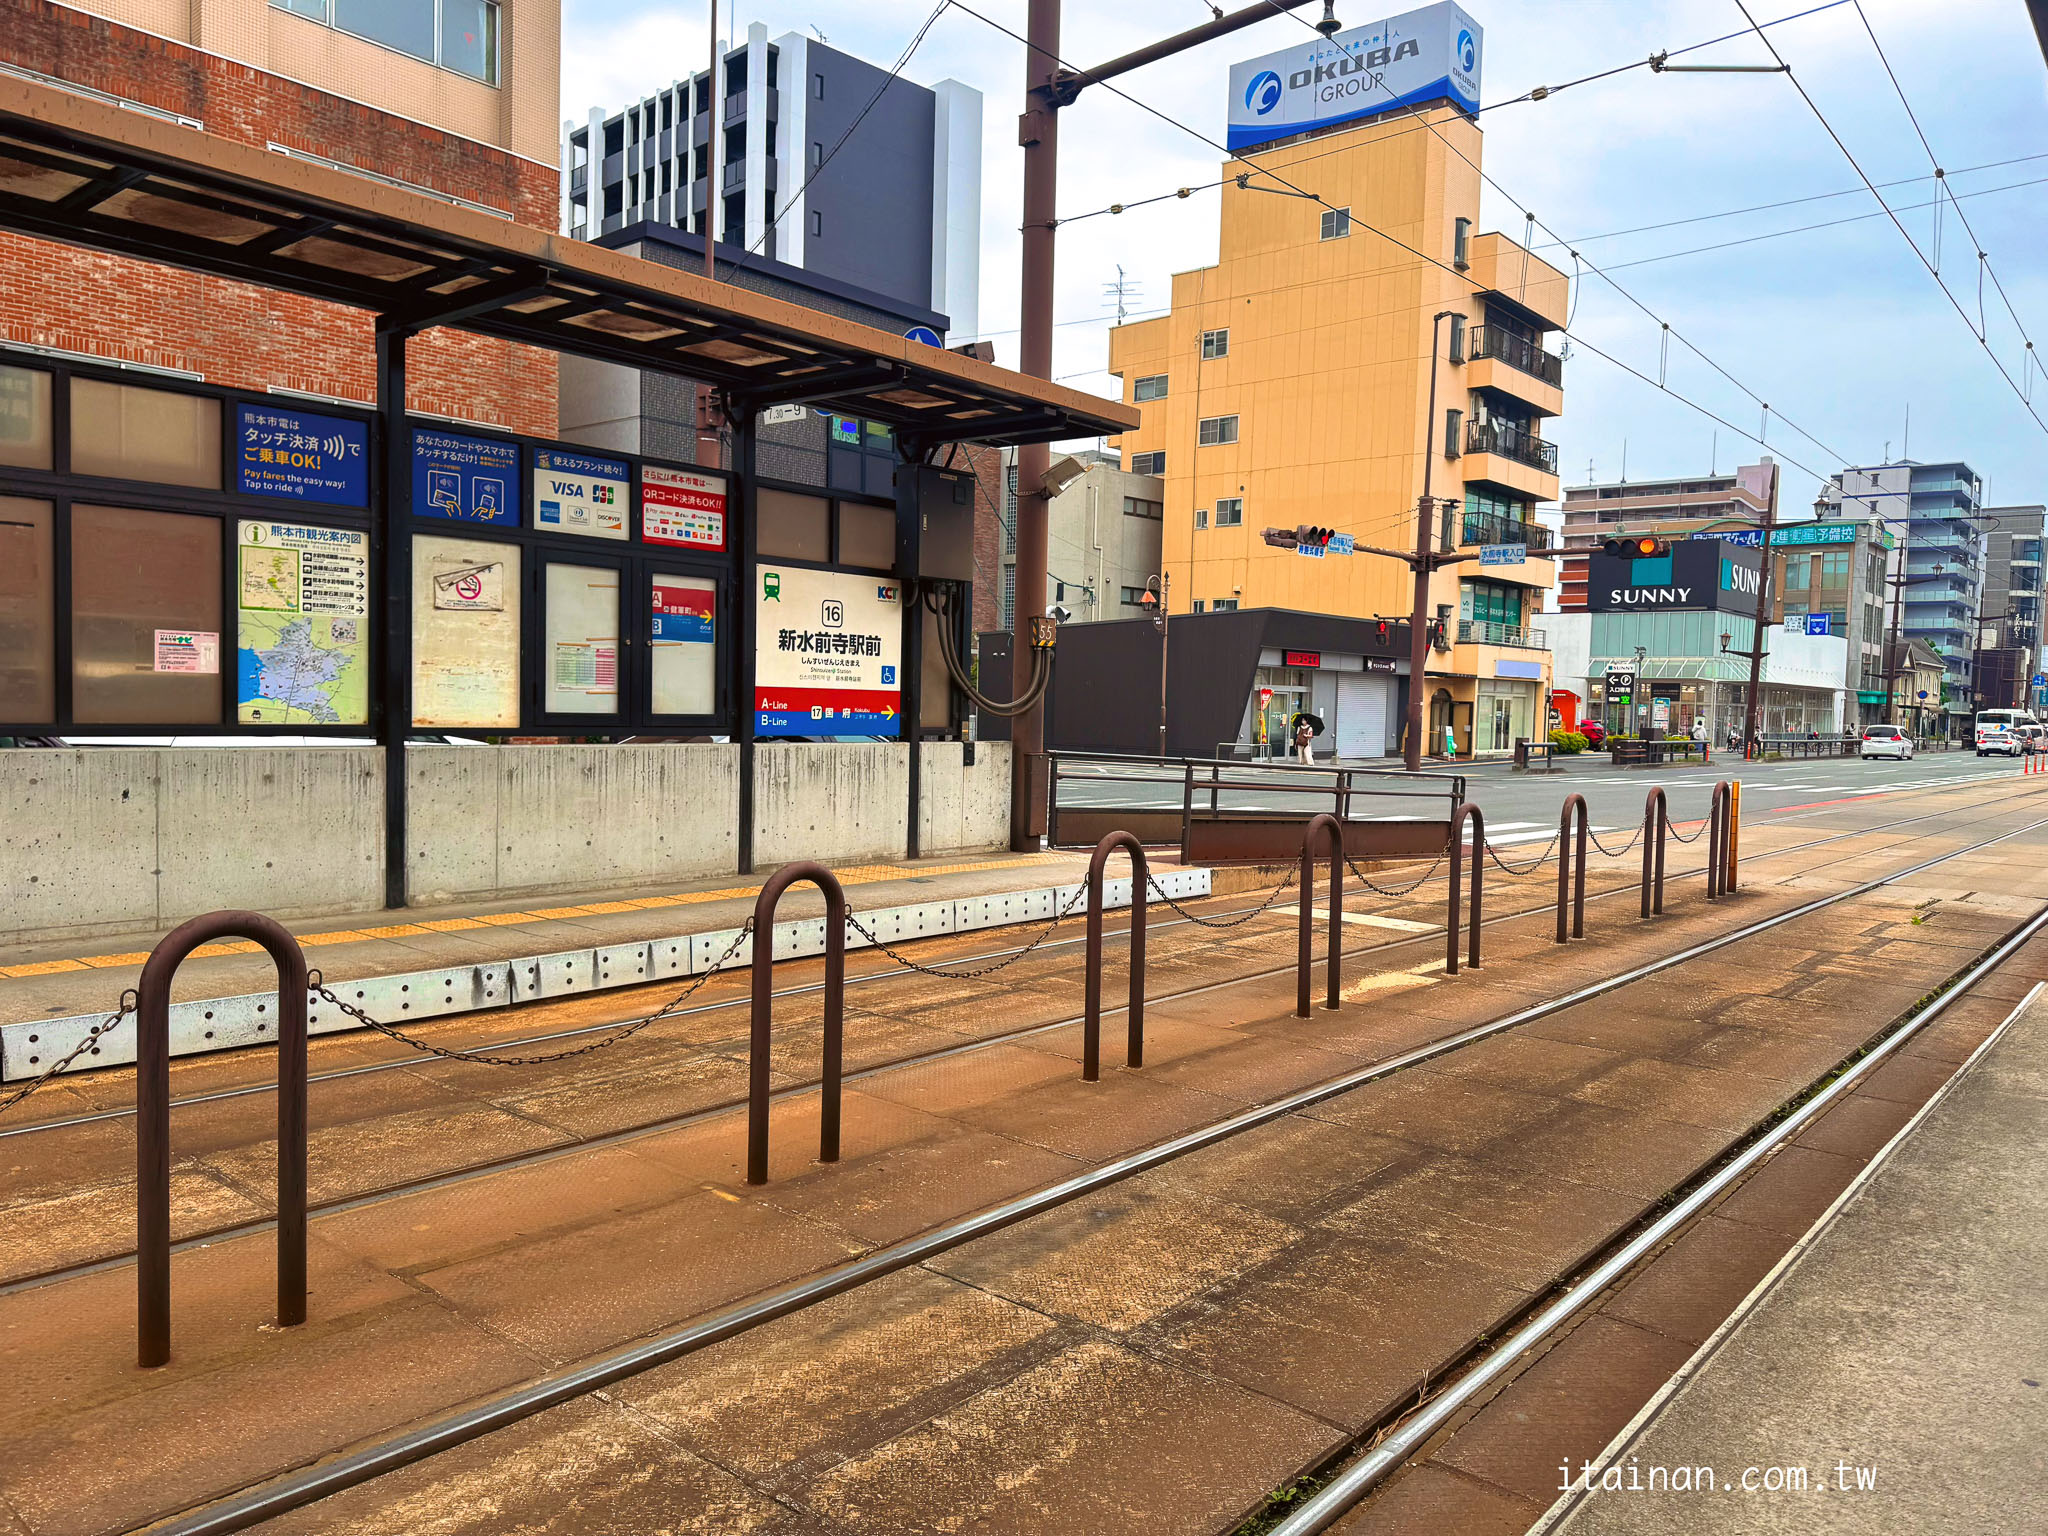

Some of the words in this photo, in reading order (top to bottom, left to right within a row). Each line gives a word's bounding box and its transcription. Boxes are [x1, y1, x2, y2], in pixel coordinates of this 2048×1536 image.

[1289, 38, 1419, 90] OKUBA
[1321, 72, 1383, 102] GROUP
[1453, 67, 1476, 91] OKUBA
[244, 413, 300, 430] 熊本市電は
[244, 428, 319, 452] タッチ決済
[416, 435, 515, 458] あなたのカードやスマホで
[244, 447, 321, 470] ご乗車OK!
[416, 446, 478, 465] タッチするだけ!
[553, 456, 622, 476] 使えるブランド続々!
[244, 468, 261, 480] Pay
[263, 471, 286, 481] fares
[287, 474, 302, 483] the
[303, 476, 324, 487] easy
[325, 480, 346, 489] way!
[244, 479, 261, 490] Tap
[263, 482, 273, 490] to
[275, 483, 293, 492] ride
[549, 480, 584, 498] VISA
[593, 486, 614, 502] JCB
[643, 489, 722, 509] QRコード決済もOK!!
[271, 525, 361, 544] 熊本市観光案内図
[878, 586, 898, 600] KCT
[1610, 588, 1691, 604] SUNNY
[825, 606, 840, 621] 16
[1040, 625, 1053, 639] 55
[778, 629, 881, 656] 新水前寺駅前
[801, 657, 860, 667] しんすいぜんじえきまえ
[761, 698, 788, 710] A-Line
[812, 708, 821, 717] 17
[761, 714, 788, 726] B-Line
